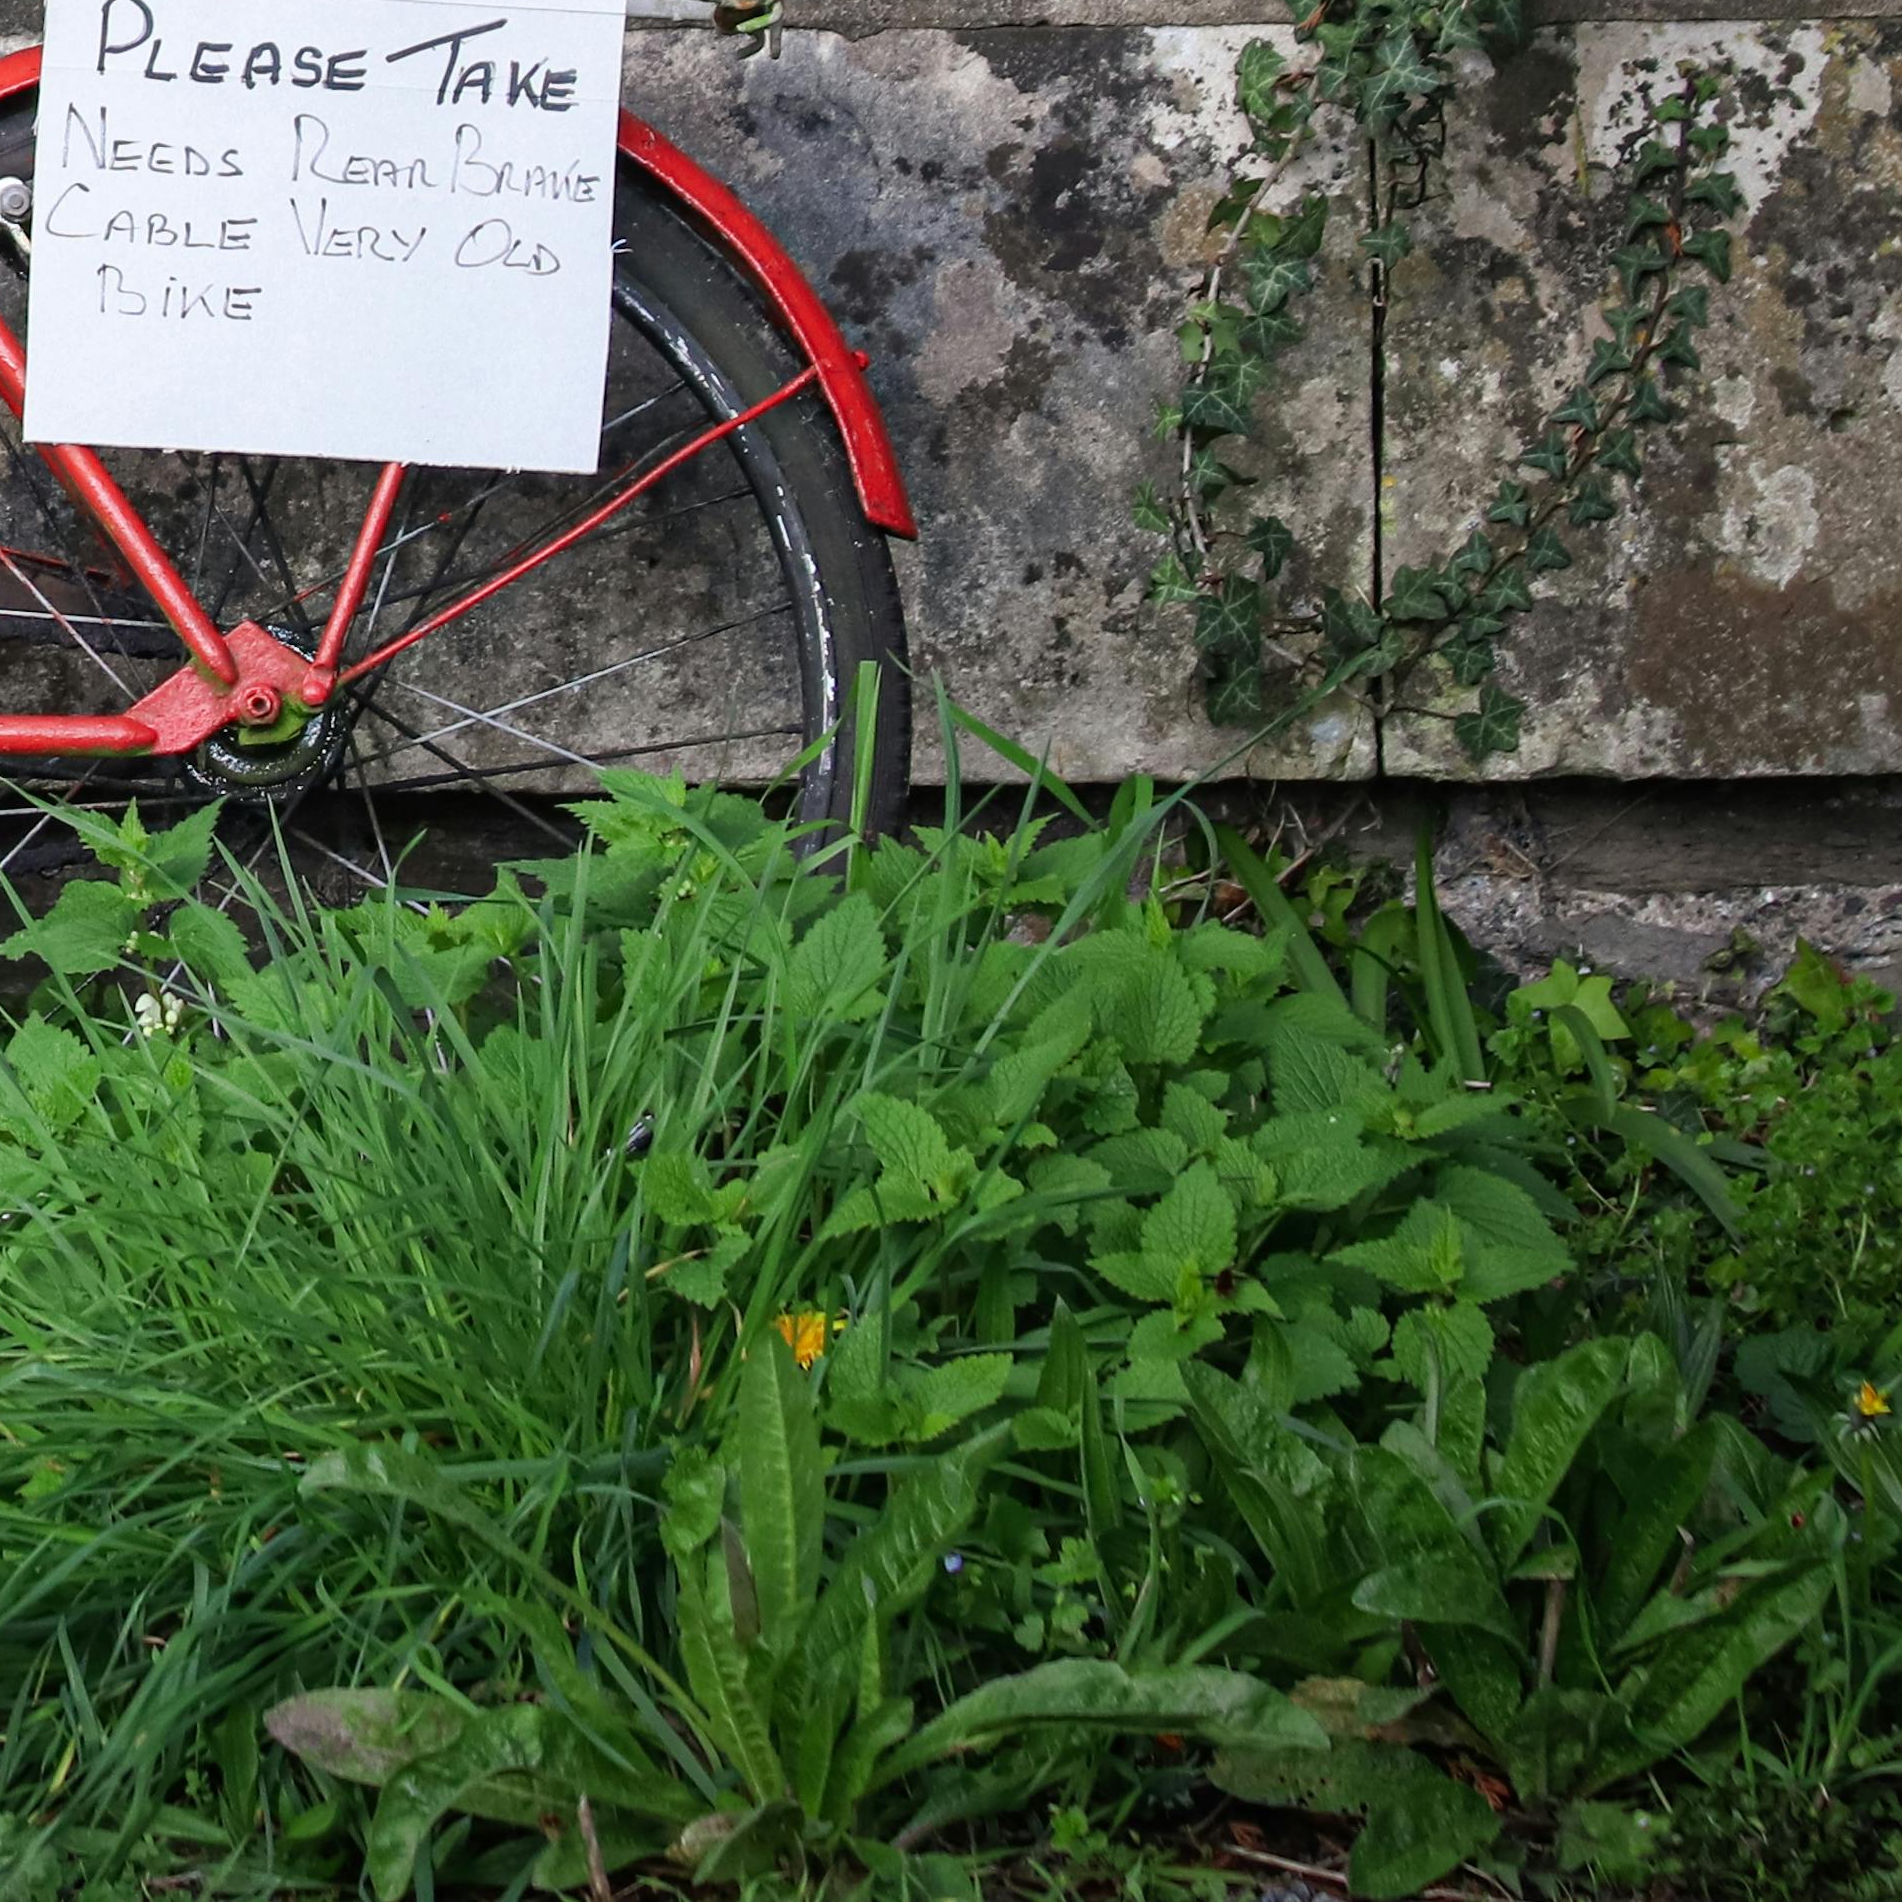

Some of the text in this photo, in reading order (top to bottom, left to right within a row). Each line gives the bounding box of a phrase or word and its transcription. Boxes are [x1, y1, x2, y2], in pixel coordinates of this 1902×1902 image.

[386, 19, 578, 111] TAKE
[62, 103, 600, 203] NEEDS REAR BRAKE
[45, 183, 561, 276] CABLE VERY OLD
